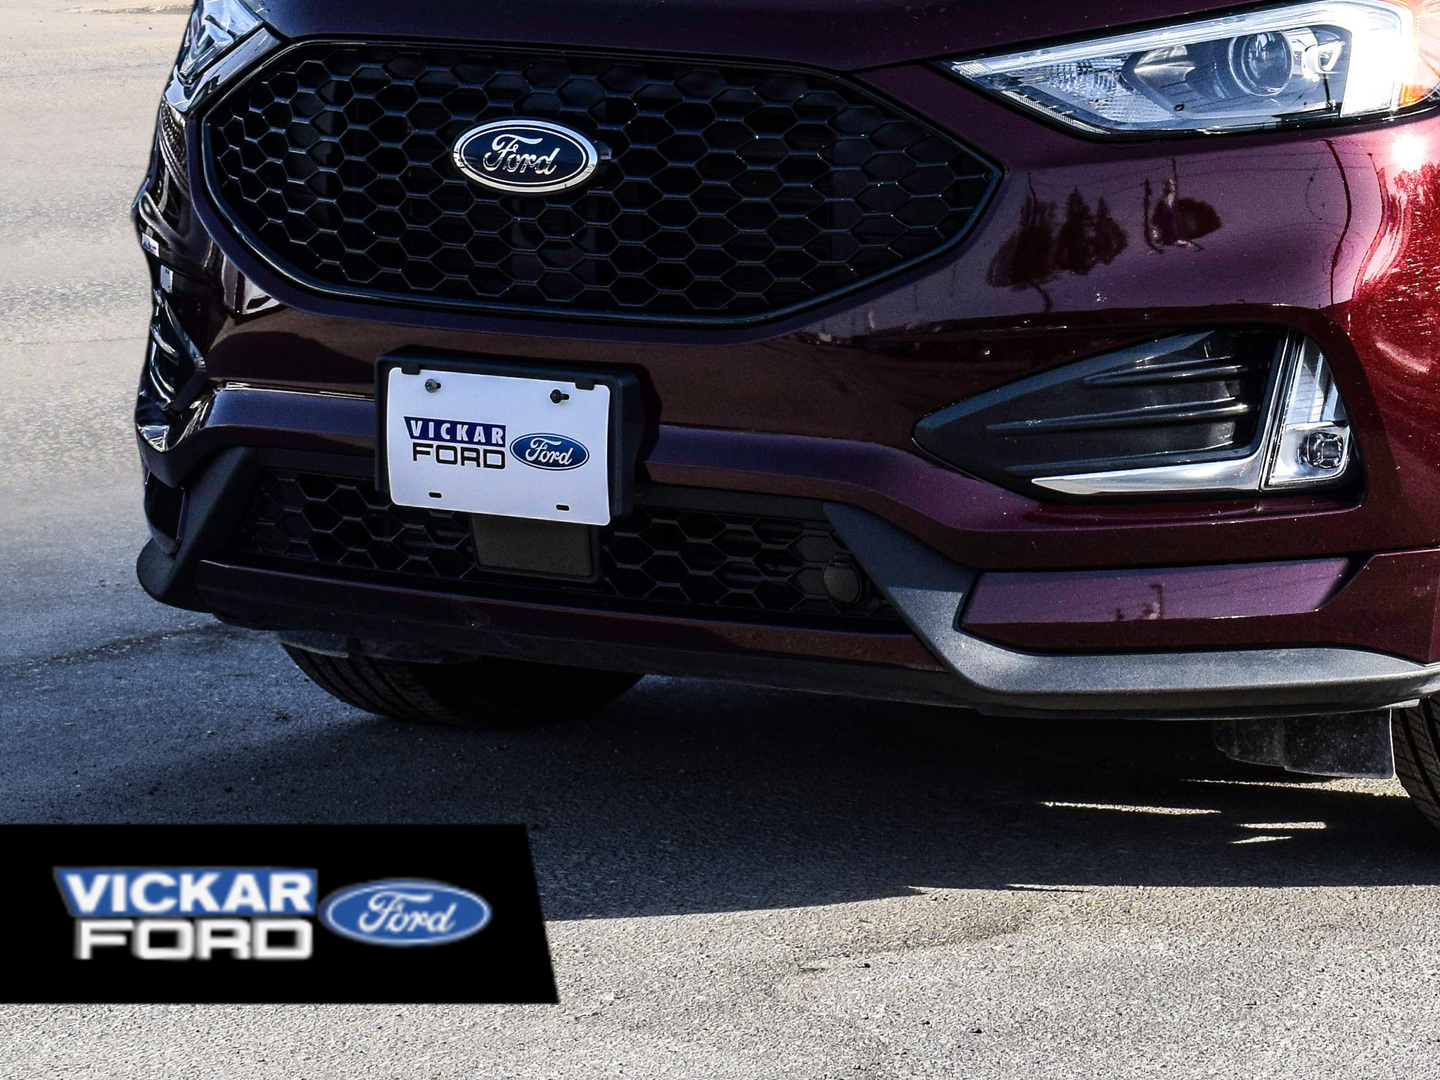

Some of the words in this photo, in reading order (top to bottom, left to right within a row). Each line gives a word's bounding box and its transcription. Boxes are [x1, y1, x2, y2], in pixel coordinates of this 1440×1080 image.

[482, 132, 560, 176] Ford
[410, 419, 504, 446] VICKAR
[412, 443, 506, 470] FORD
[524, 436, 573, 467] Ford
